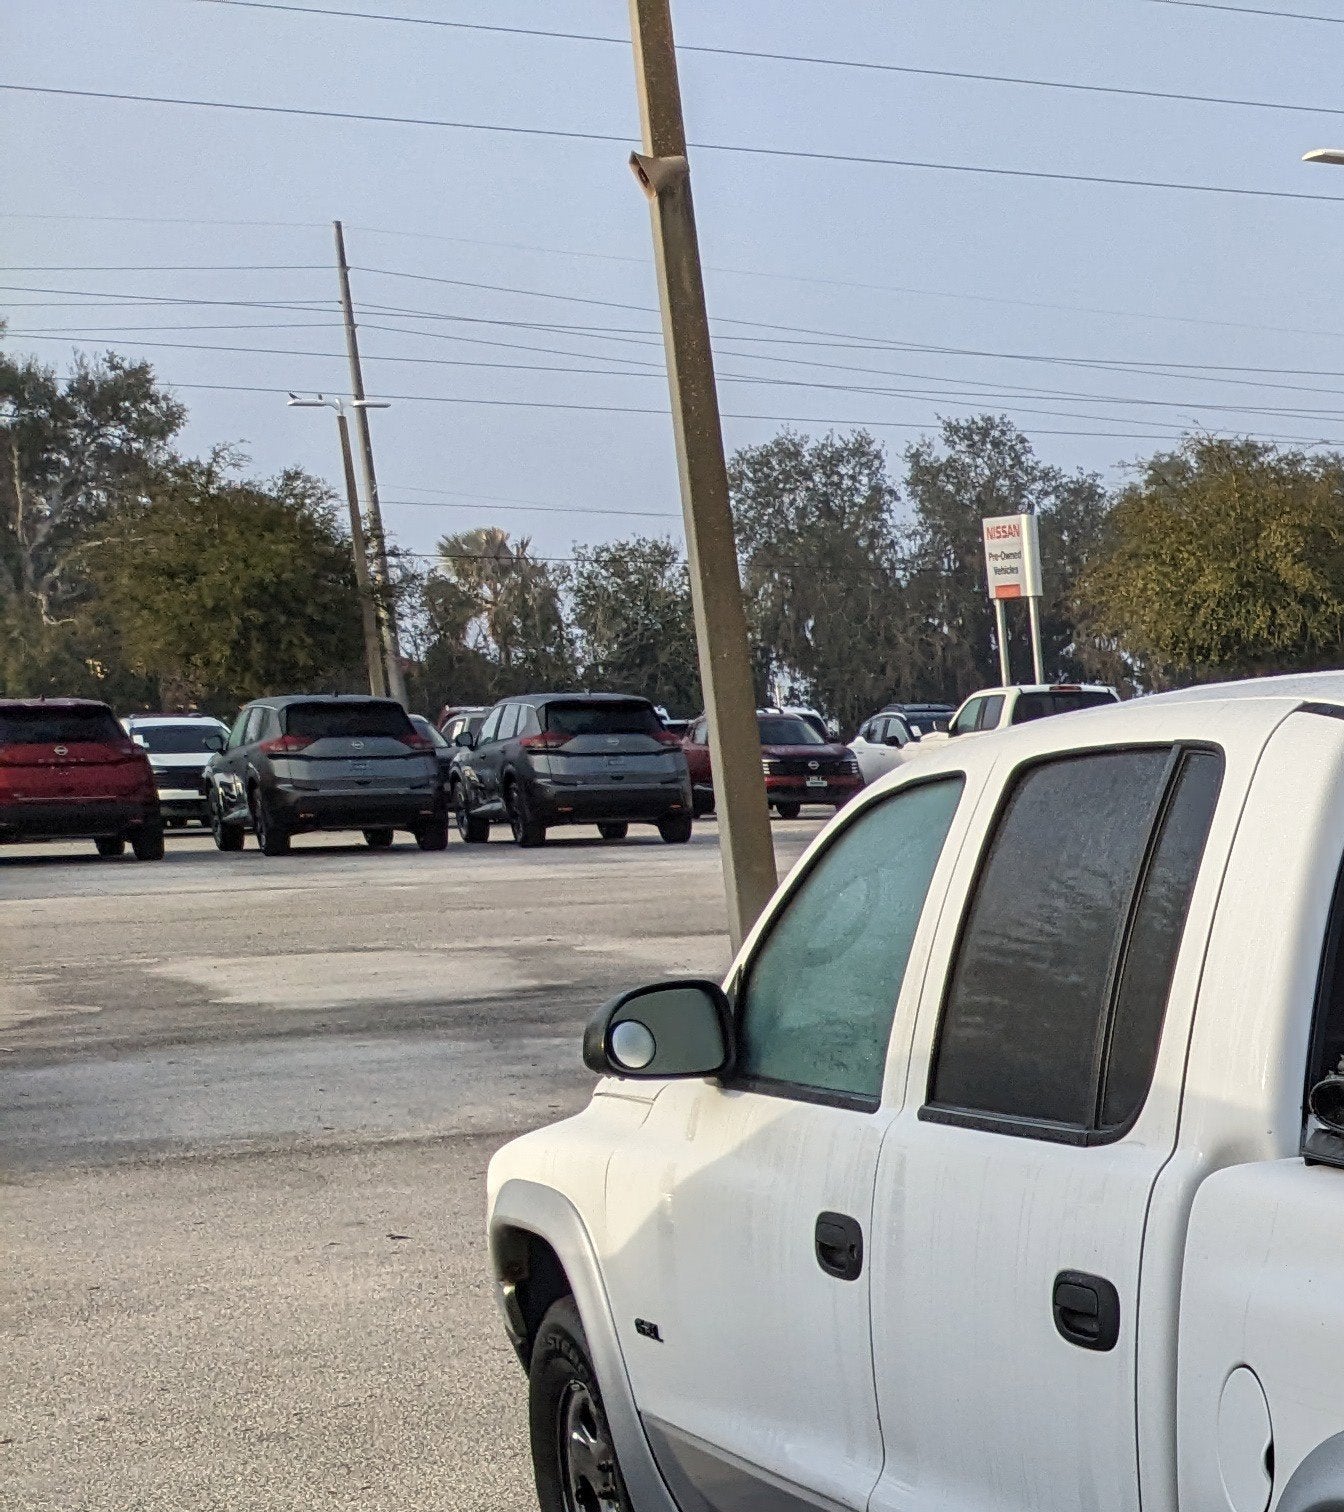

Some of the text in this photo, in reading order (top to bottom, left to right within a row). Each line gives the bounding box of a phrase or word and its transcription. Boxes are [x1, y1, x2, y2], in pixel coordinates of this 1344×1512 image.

[986, 524, 1020, 540] NISSAN
[989, 551, 1021, 561] Pre-Owned
[994, 565, 1019, 575] Vehicles
